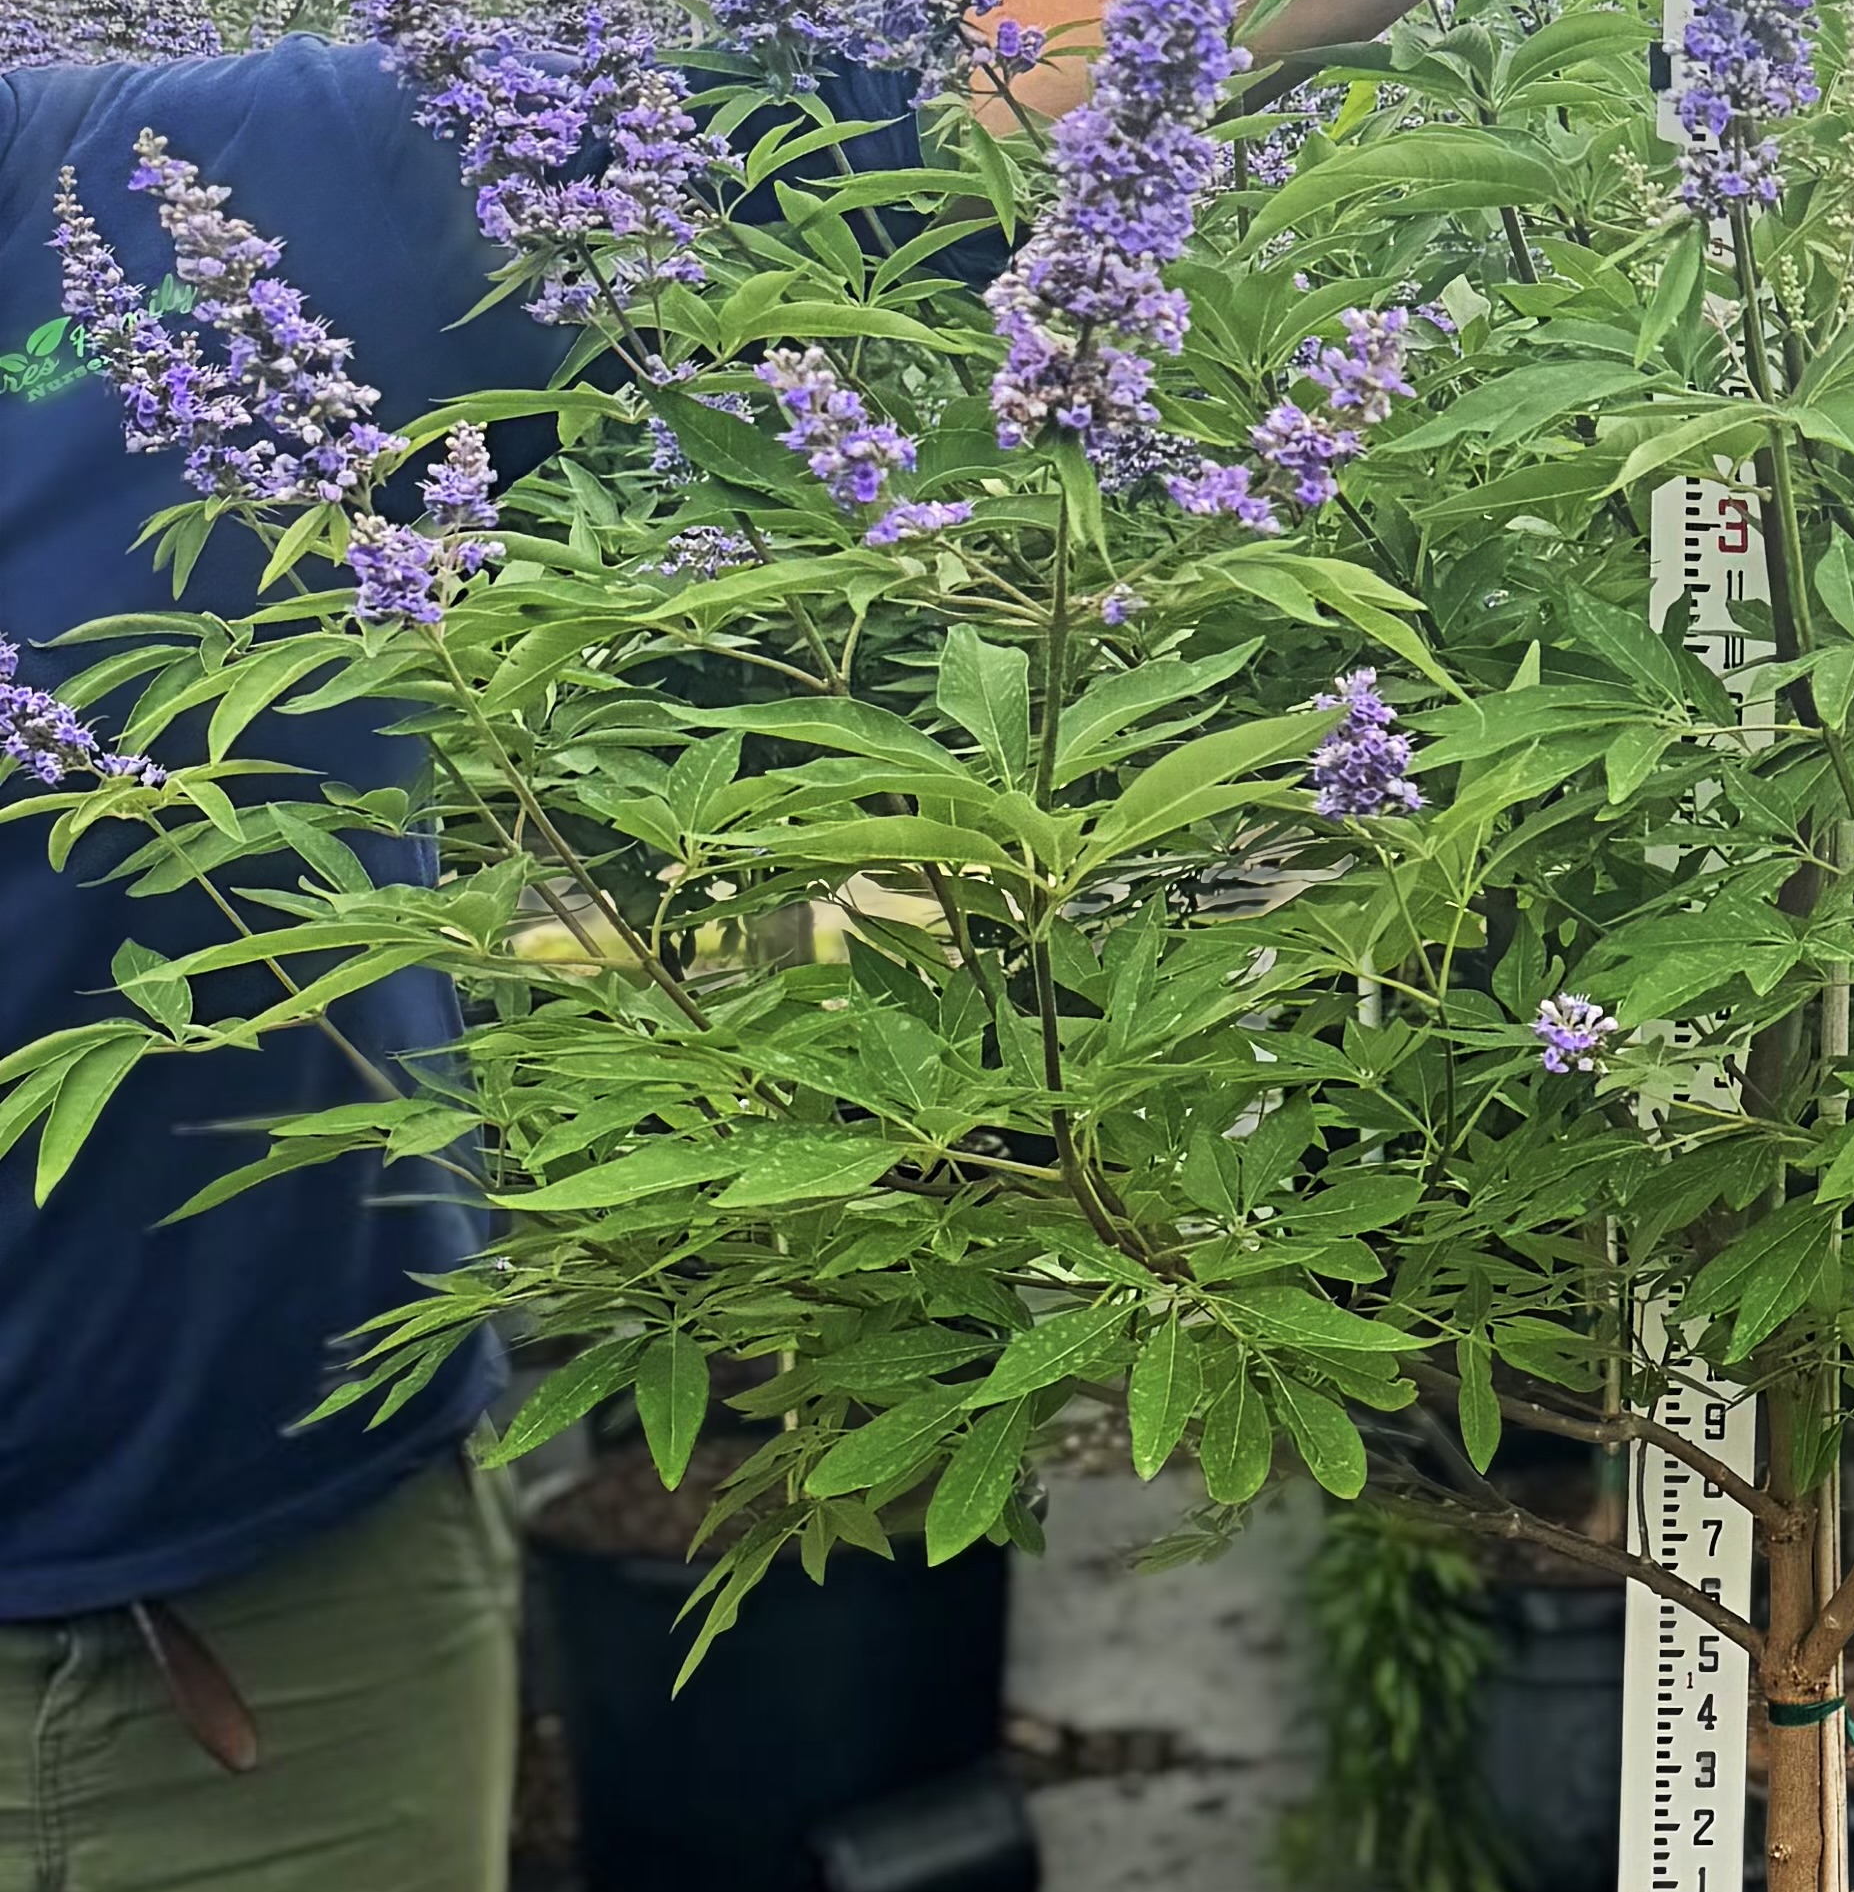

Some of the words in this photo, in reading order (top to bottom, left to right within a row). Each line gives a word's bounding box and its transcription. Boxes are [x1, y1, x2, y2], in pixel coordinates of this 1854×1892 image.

[0, 357, 59, 394] res
[1719, 498, 1748, 553] 3
[1705, 1403, 1725, 1439] 9
[1702, 1520, 1722, 1557] 7
[1698, 1635, 1720, 1672] 5
[1686, 1672, 1694, 1689] 1
[1697, 1693, 1718, 1731] 4
[1694, 1751, 1716, 1788] 3
[1693, 1809, 1714, 1846] 2
